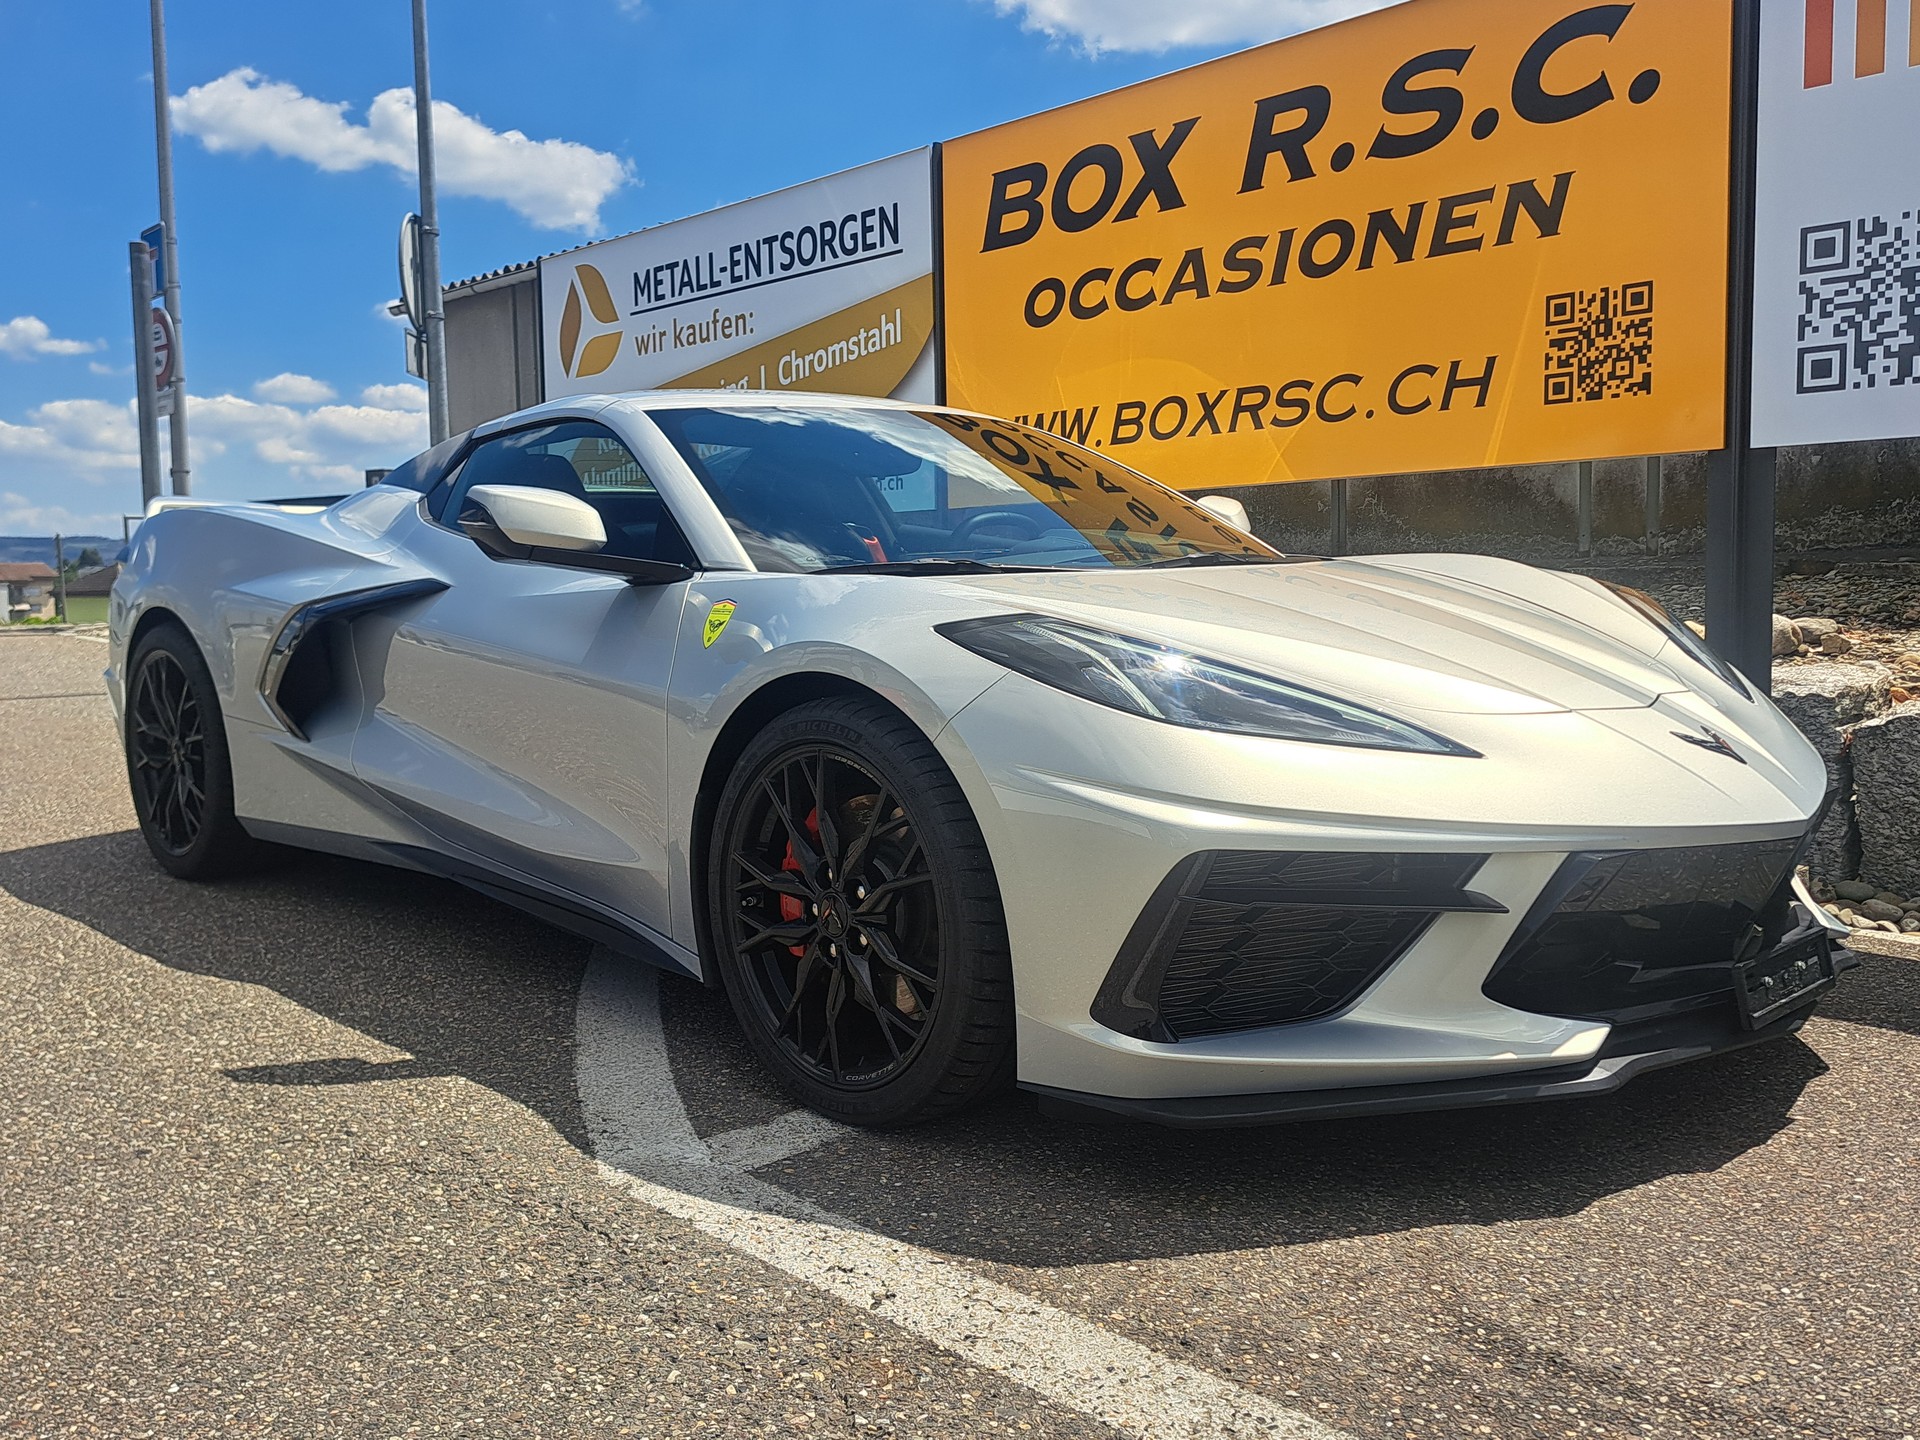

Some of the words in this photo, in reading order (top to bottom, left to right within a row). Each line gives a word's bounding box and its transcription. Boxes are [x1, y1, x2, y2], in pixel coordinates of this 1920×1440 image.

[980, 116, 1202, 253] BOX
[1236, 3, 1662, 195] R.S.C.
[632, 202, 900, 307] METALL-ENTSORGEN
[1023, 171, 1576, 328] OCCASIONEN
[634, 323, 667, 357] wir
[672, 308, 755, 350] kaufen:
[778, 308, 902, 386] Chromstahl
[797, 721, 859, 743] MICHELIN
[845, 1062, 896, 1081] CORVETTE
